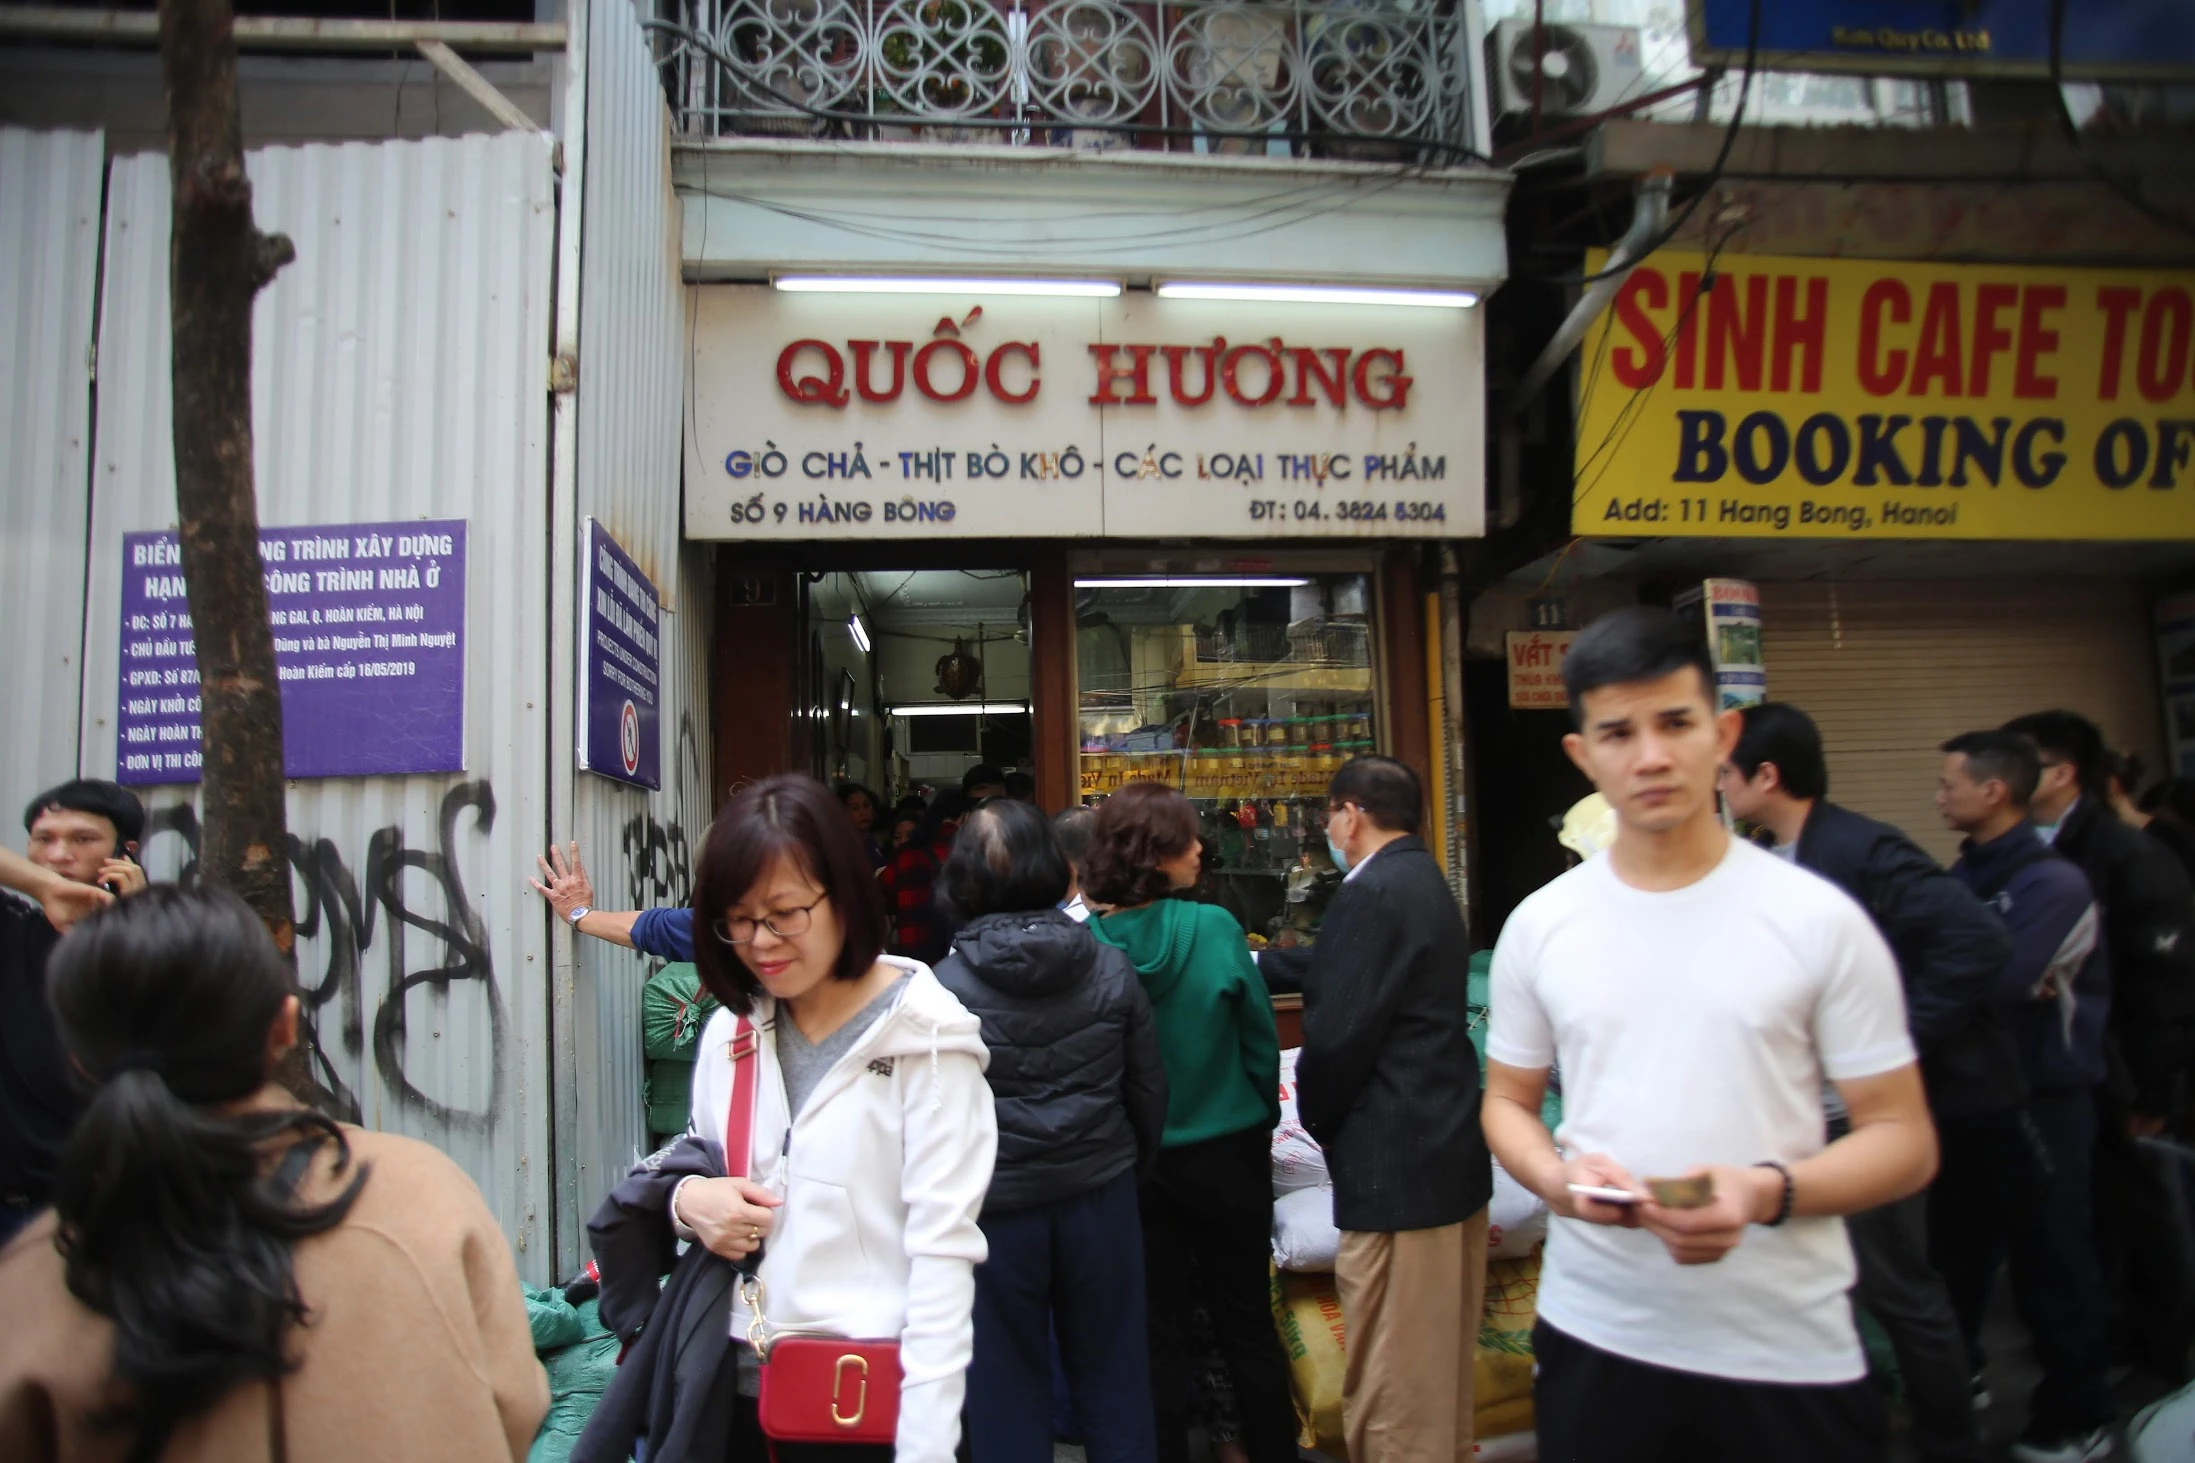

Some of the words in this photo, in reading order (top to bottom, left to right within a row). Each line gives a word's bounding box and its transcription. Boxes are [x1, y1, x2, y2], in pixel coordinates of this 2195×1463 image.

[1611, 267, 1829, 393] SINH
[1857, 277, 2067, 398] CAFE
[2096, 285, 2195, 403] TO
[777, 305, 1040, 408] QUỐC
[1088, 336, 1413, 408] HƯƠNG
[1672, 410, 2067, 489] BOOKING
[725, 440, 788, 478] GIÒ
[802, 441, 872, 478] CHẢ
[899, 447, 956, 483] THỊT
[967, 442, 1010, 478] BÒ
[1020, 444, 1084, 480] KHÔ
[1115, 443, 1183, 480] CÁC
[1196, 453, 1263, 486] LOẠI
[1278, 453, 1351, 487] THỰC
[1364, 441, 1445, 480] PHẨM
[731, 492, 765, 523] SỐ
[773, 502, 788, 523] 9
[799, 493, 872, 523] HÀNG
[1250, 501, 1286, 520] ĐT:
[1336, 502, 1387, 520] 3824
[1604, 498, 1669, 523] Add:
[1680, 499, 1706, 521] 11
[1719, 500, 1791, 530] Hang
[1800, 501, 1872, 531] Bong,
[1881, 501, 1957, 526] Hanoi
[134, 536, 181, 566] BIỂN
[292, 536, 350, 560] TRÌNH
[355, 533, 394, 558] XÂY
[399, 533, 453, 560] DỤNG
[316, 567, 374, 592] TRÌNH
[380, 564, 421, 589] NHÀ
[426, 560, 441, 588] Ở
[152, 610, 167, 629] SỐ
[326, 605, 354, 623] HOÀN
[389, 604, 403, 621] HÀ
[1537, 604, 1560, 625] 11
[303, 636, 315, 650] và
[317, 636, 331, 649] bà
[333, 631, 371, 651] Nguyễn
[392, 632, 418, 647] Minh
[420, 631, 456, 649] Nguyệt
[279, 665, 305, 680] Hoàn
[308, 662, 334, 679] Kiếm
[359, 662, 416, 678] 16/05/2019
[129, 696, 158, 714] NGÀY
[128, 724, 157, 742] NGÀY
[159, 724, 188, 741] HOÀN
[165, 753, 182, 768] THI
